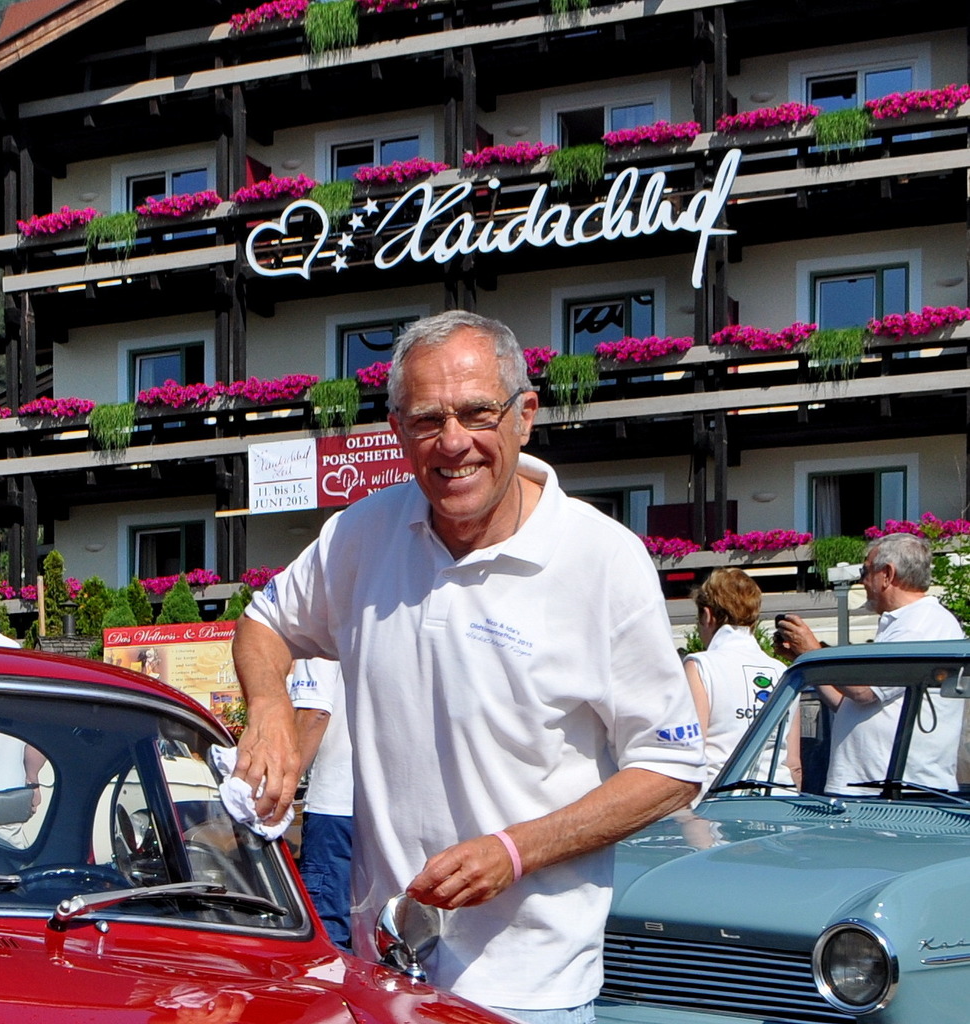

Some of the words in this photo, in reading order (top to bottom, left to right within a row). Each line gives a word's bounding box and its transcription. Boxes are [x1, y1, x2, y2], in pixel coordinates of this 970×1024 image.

[374, 148, 743, 289] Haidachhof
[346, 433, 399, 449] OLDTIM
[258, 487, 271, 497] 11.
[274, 485, 289, 495] bis
[292, 483, 306, 494] 15.
[254, 497, 282, 509] JUNI
[286, 495, 309, 507] 2015
[107, 631, 132, 645] Das
[183, 628, 196, 640] &
